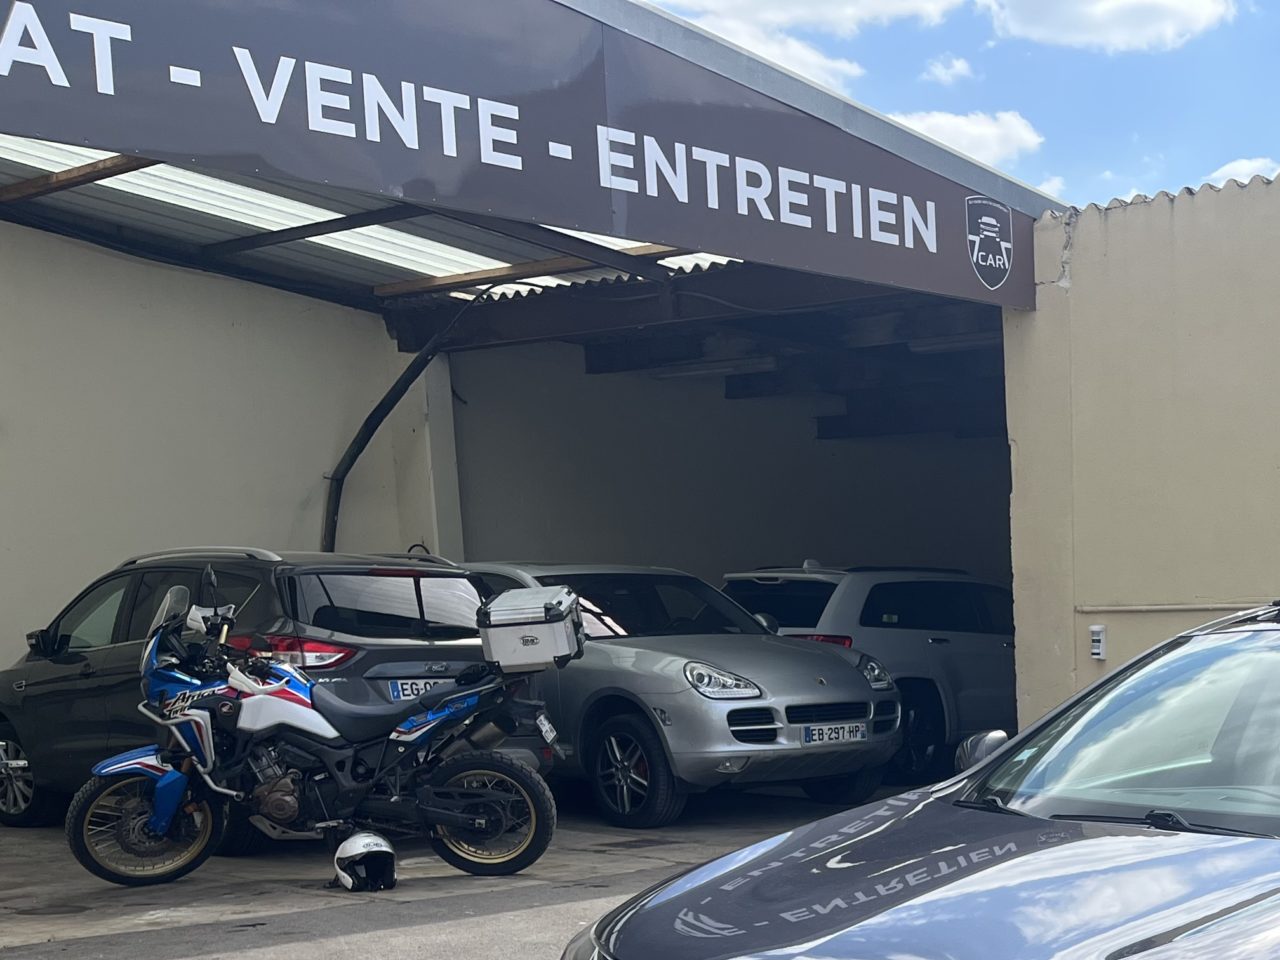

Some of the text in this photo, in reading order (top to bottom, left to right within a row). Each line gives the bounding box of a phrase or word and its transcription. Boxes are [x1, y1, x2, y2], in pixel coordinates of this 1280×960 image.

[232, 46, 523, 171] VENTE
[597, 124, 938, 254] ENTRETIEN
[811, 725, 861, 742] EB-297-HP
